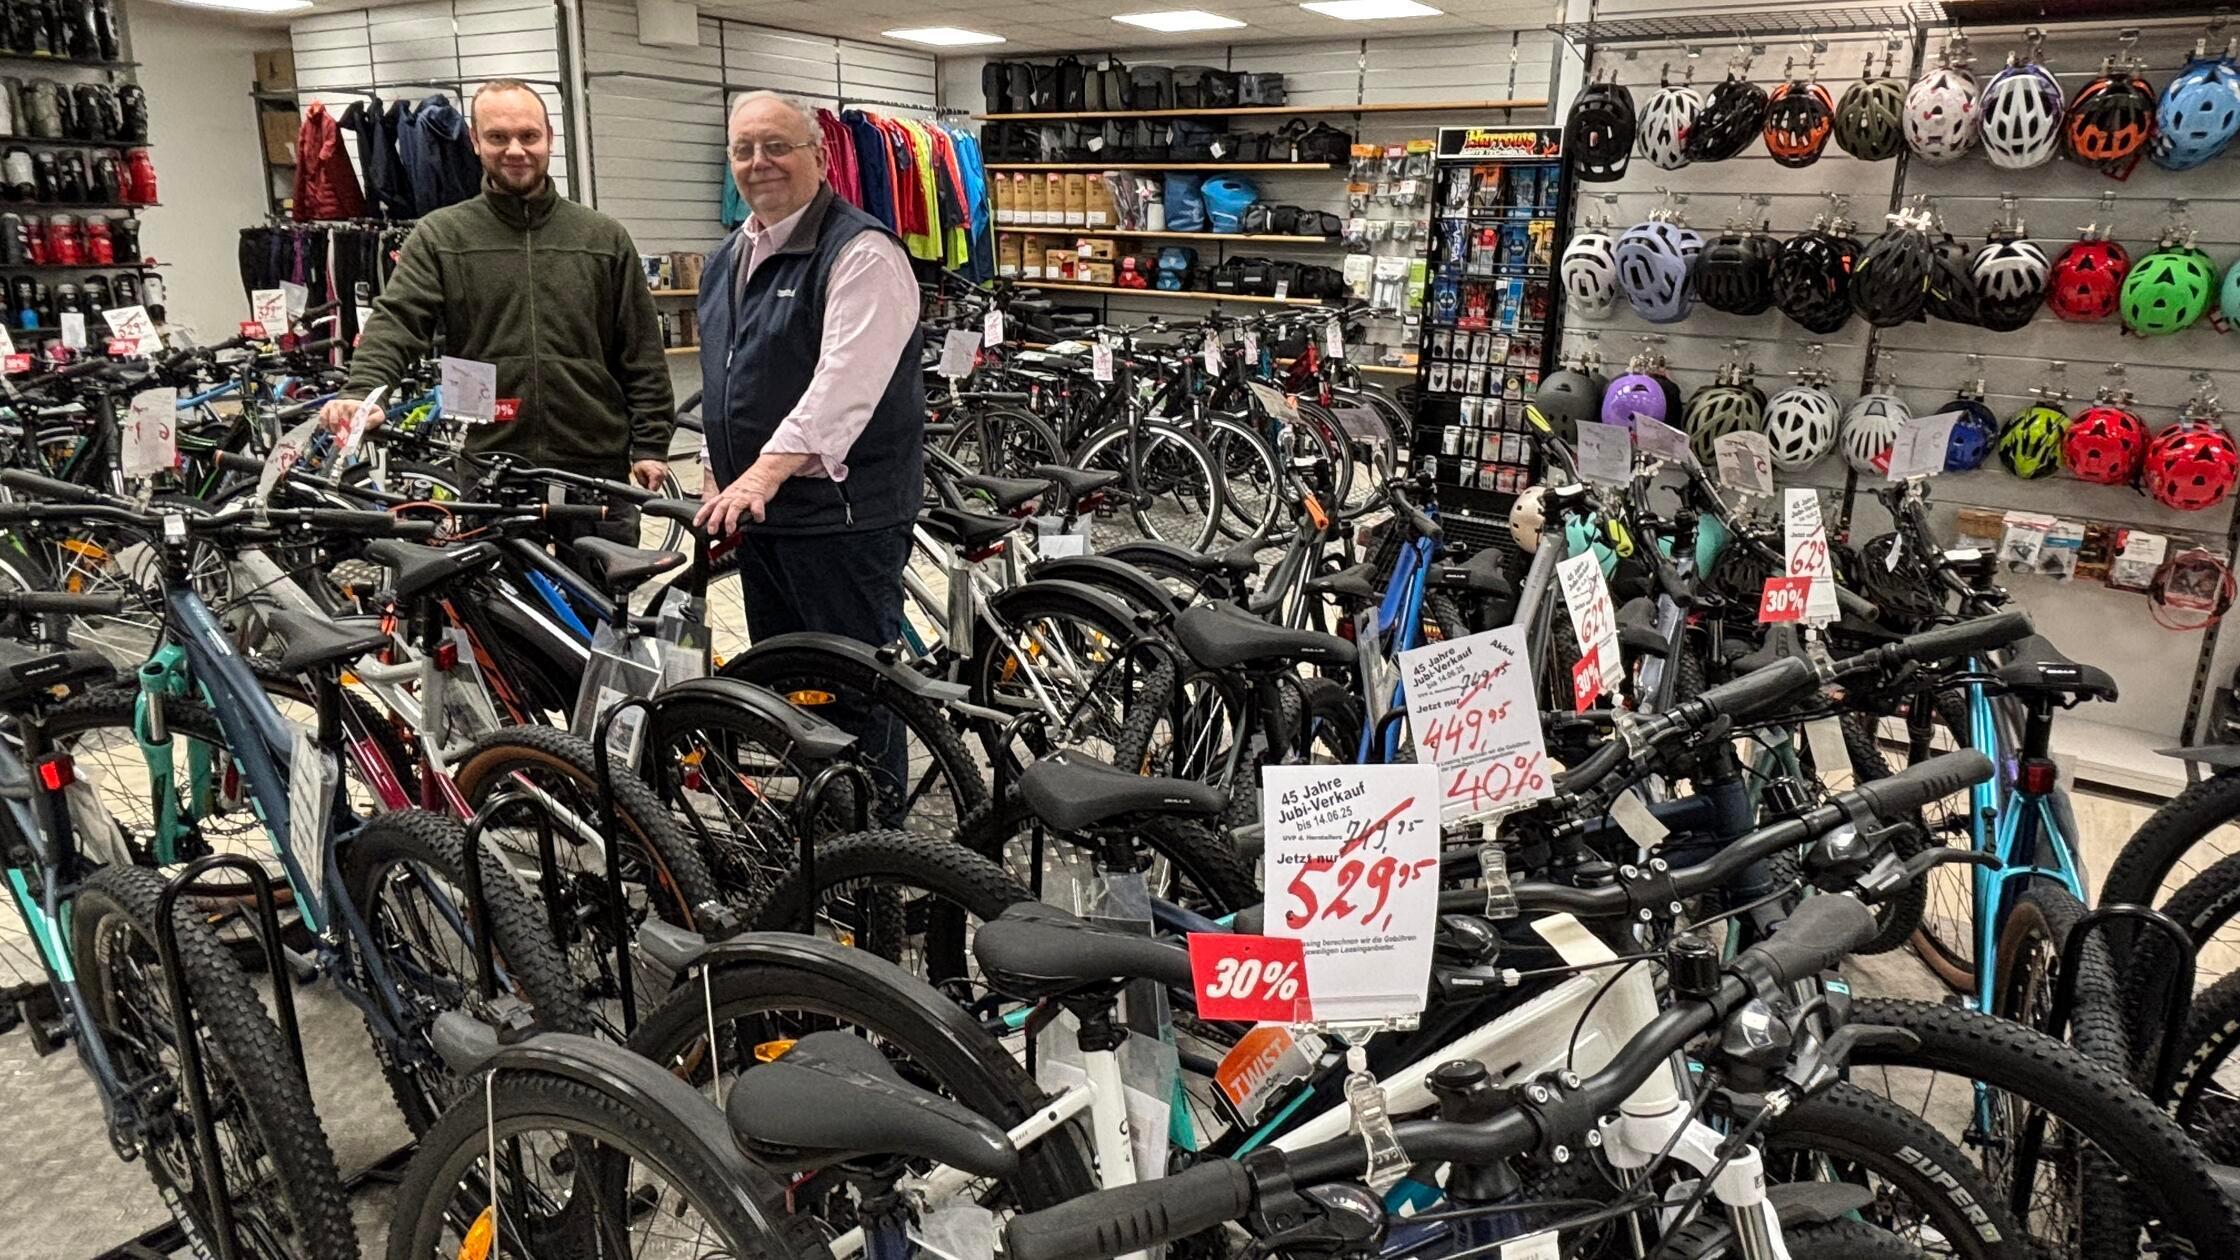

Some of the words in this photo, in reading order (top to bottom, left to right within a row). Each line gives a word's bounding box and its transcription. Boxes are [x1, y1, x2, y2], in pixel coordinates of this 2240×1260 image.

[1463, 128, 1537, 149] Harrows
[1765, 588, 1804, 613] 30%
[1413, 663, 1426, 675] 45
[1428, 647, 1456, 667] Jahre
[1490, 639, 1515, 657] Akku
[1413, 646, 1473, 688] Jubi-Verkauf
[1576, 659, 1601, 698] 30%
[1416, 702, 1442, 714] Jetzt
[1444, 697, 1460, 707] nur
[1281, 790, 1299, 806] 45
[1303, 777, 1342, 799] Jahre
[1447, 751, 1544, 812] 40%
[1278, 781, 1366, 824] Jubi-Verkauf
[1296, 819, 1312, 832] bis
[1313, 806, 1353, 827] 14.06.25
[1277, 853, 1313, 865] Jetzt
[1316, 854, 1340, 864] nur
[1322, 937, 1359, 947] berechnen
[1206, 957, 1299, 1001] 30%
[1230, 1037, 1284, 1099] TWIST
[1893, 1145, 2004, 1243] SUPERO
